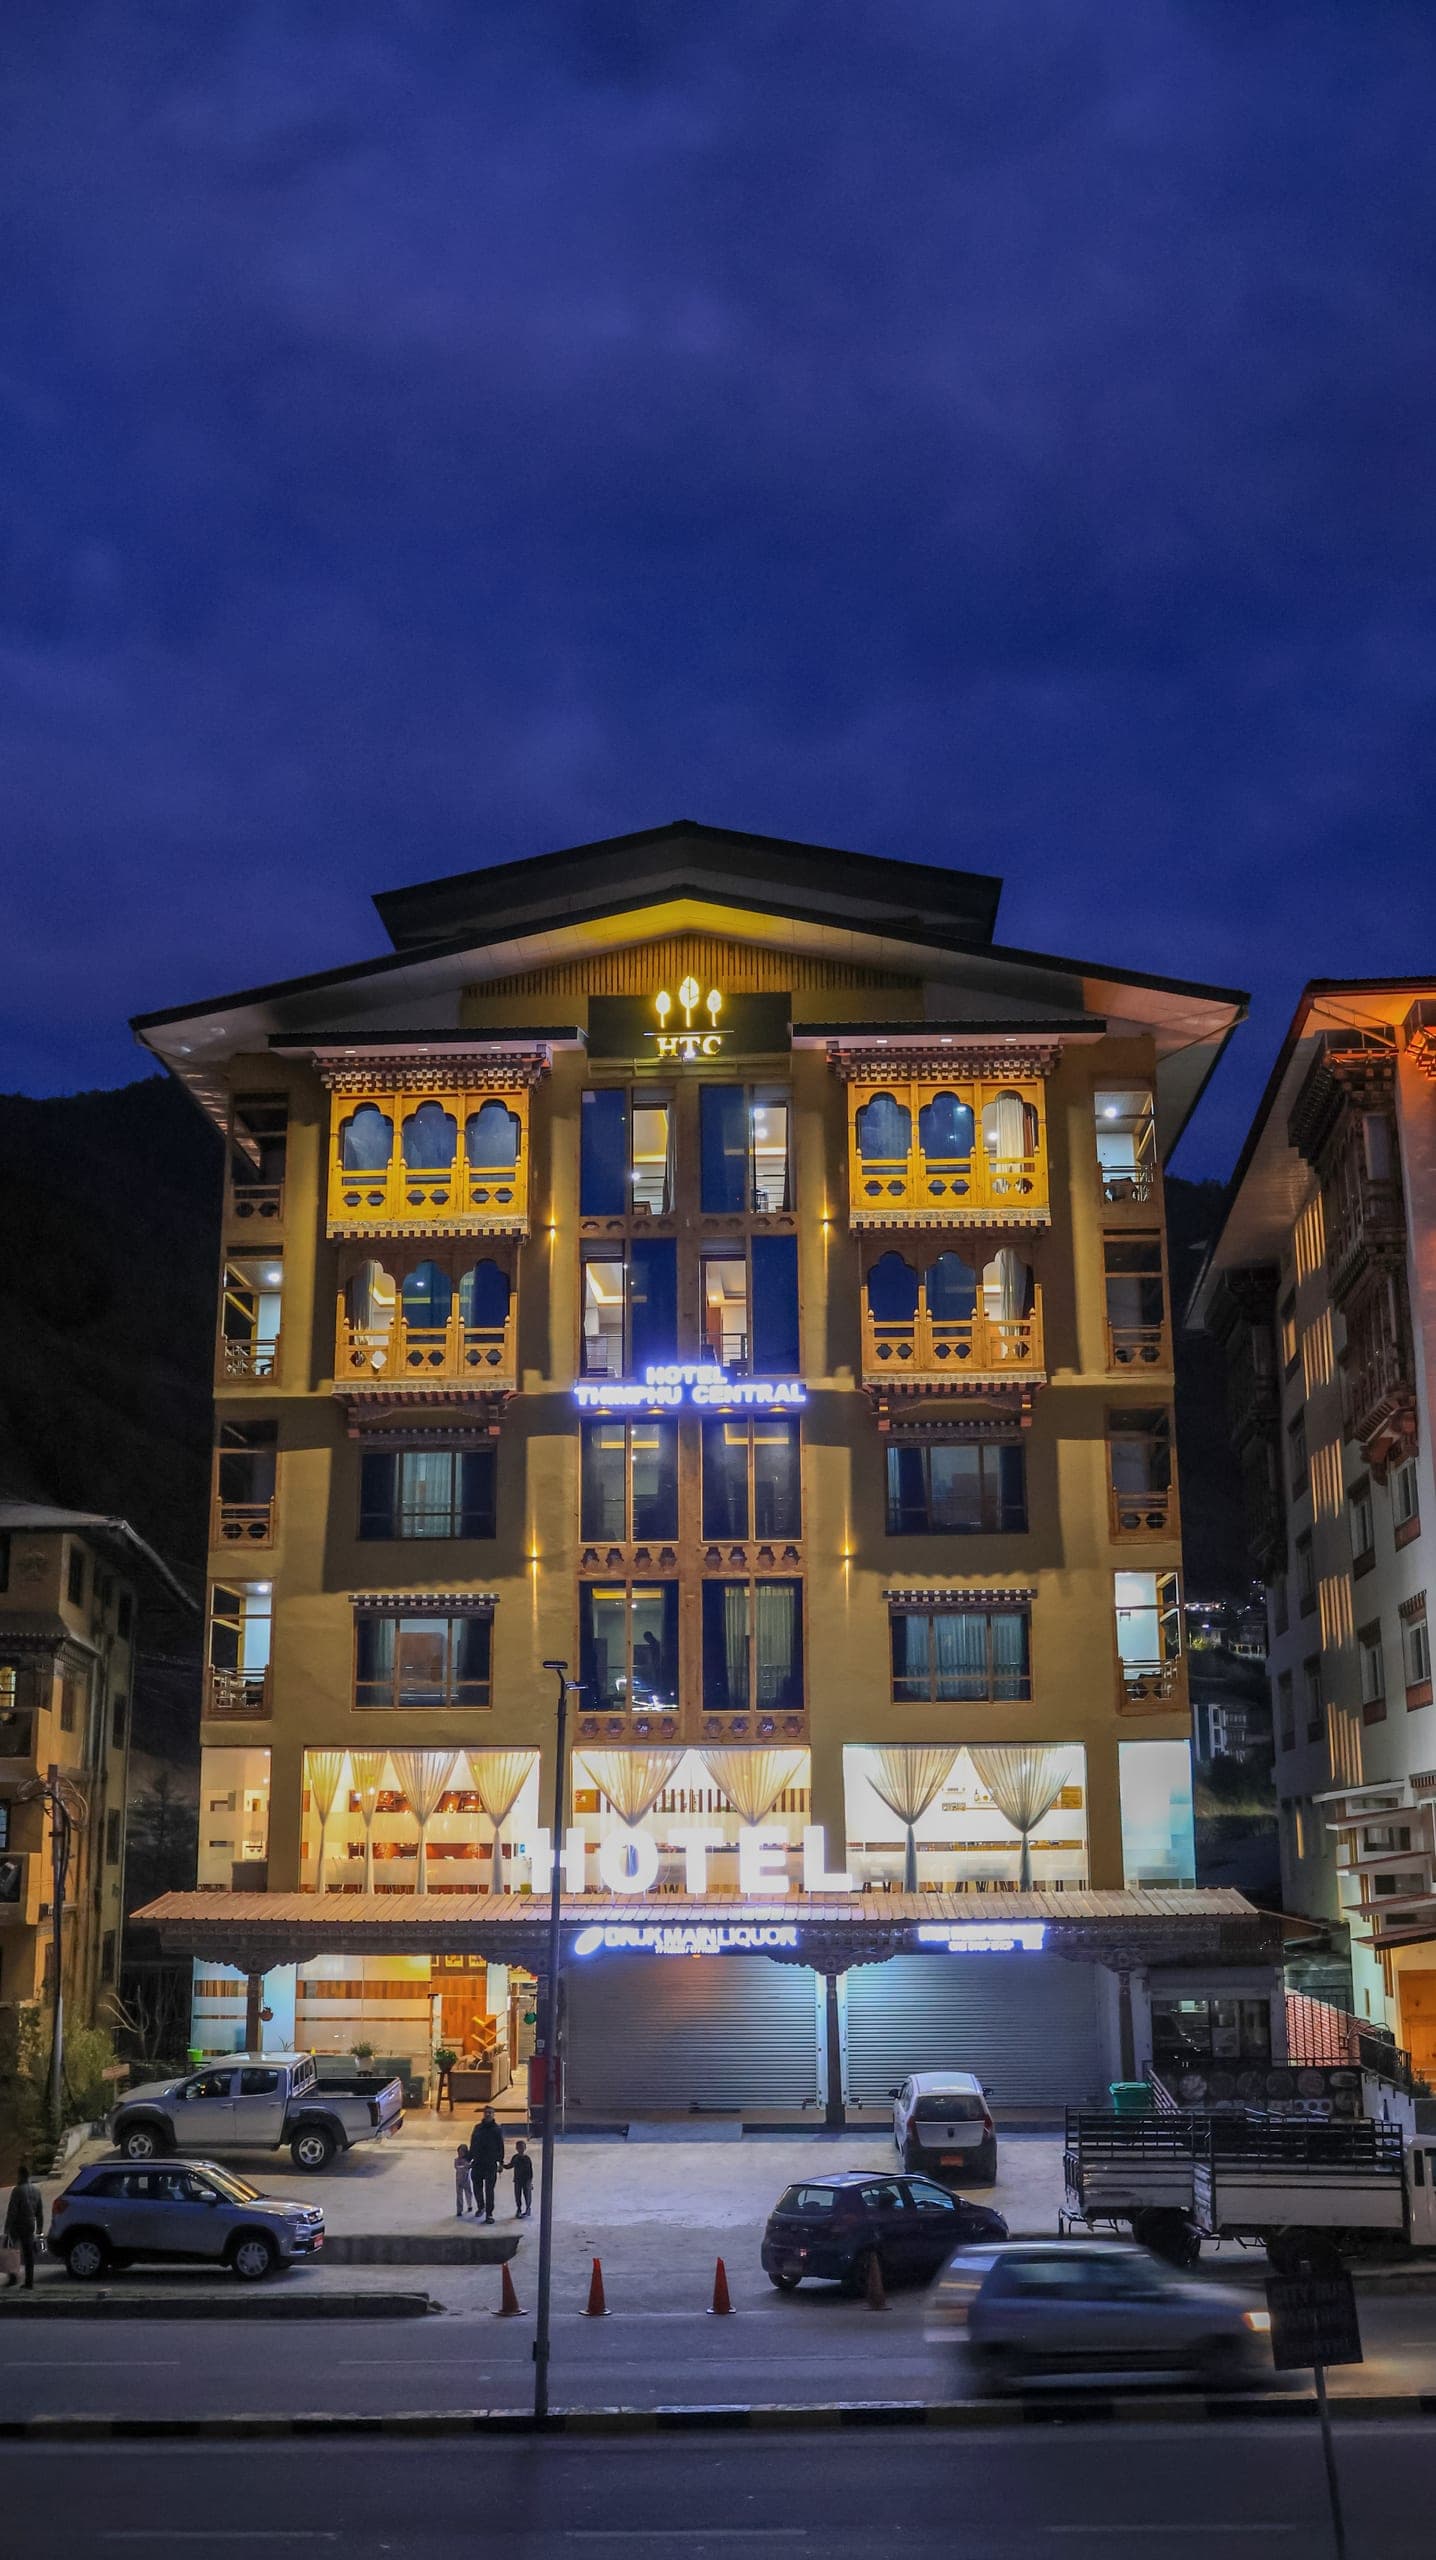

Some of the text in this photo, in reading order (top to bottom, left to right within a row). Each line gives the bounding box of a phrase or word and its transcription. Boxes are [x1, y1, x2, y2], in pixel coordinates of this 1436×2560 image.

[656, 1035, 722, 1058] HTC
[646, 1365, 727, 1385] HOTEL
[574, 1383, 806, 1405] THIMPHU CENTRAL
[531, 1825, 853, 1895] HOTEL
[718, 1926, 798, 1947] LIQUOR
